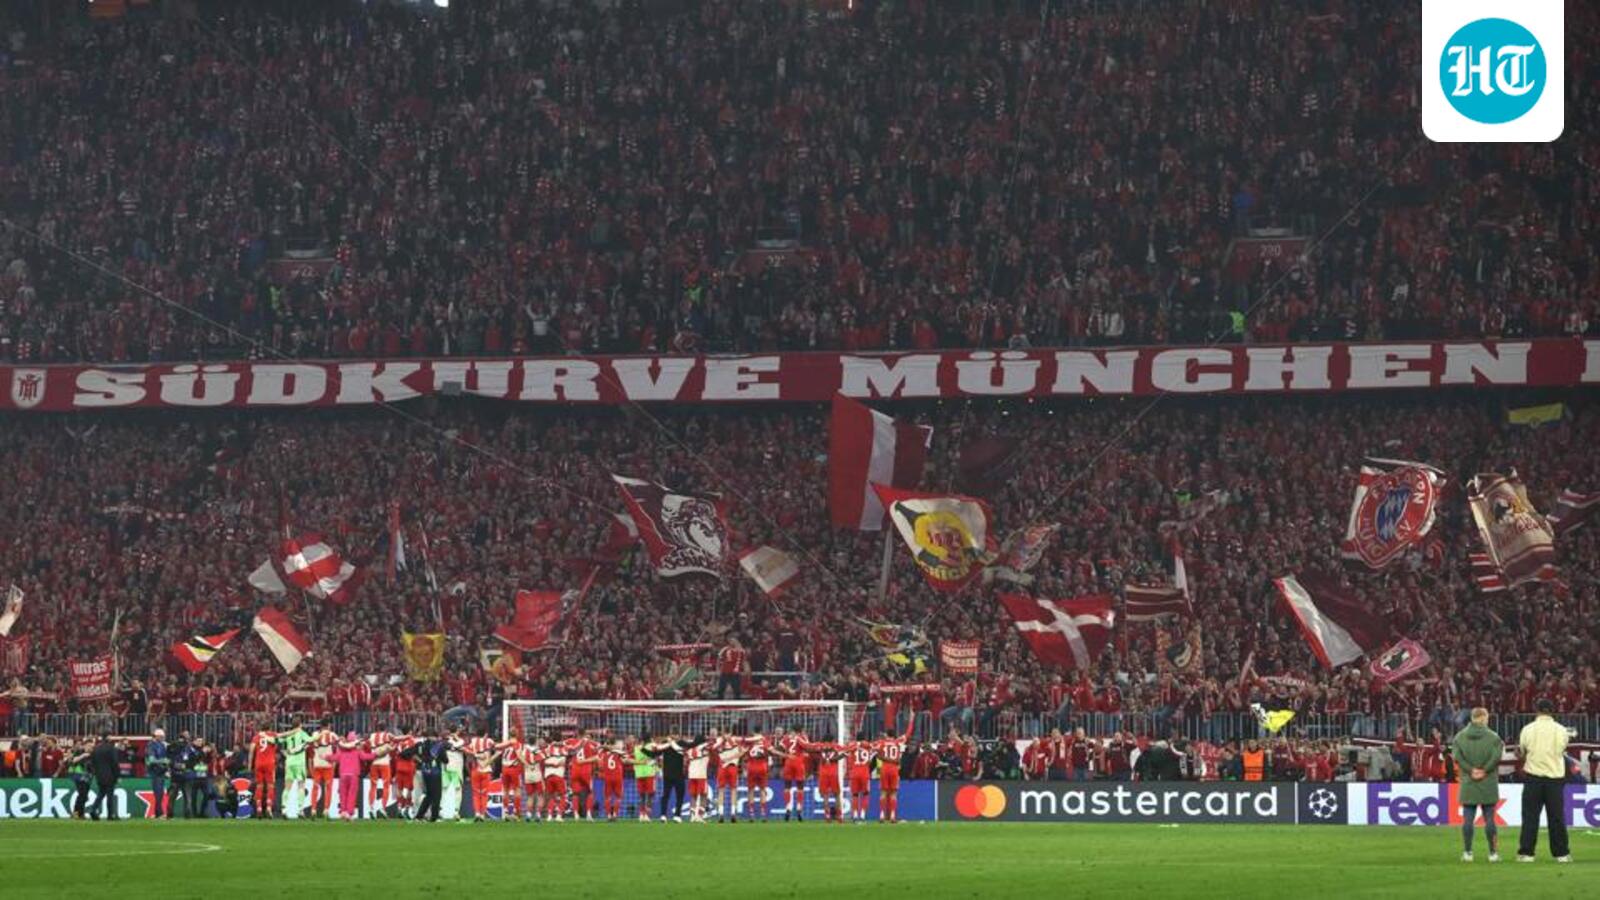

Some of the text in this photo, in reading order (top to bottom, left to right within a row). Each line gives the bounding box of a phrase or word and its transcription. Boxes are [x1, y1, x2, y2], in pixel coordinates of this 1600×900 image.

[73, 356, 781, 406] SÜDKURVE
[838, 342, 1532, 397] MÜNCHEN
[258, 738, 268, 753] 9
[882, 745, 898, 760] 10
[607, 755, 617, 769] 6
[854, 749, 869, 765] 19
[1020, 785, 1277, 815] mastercard
